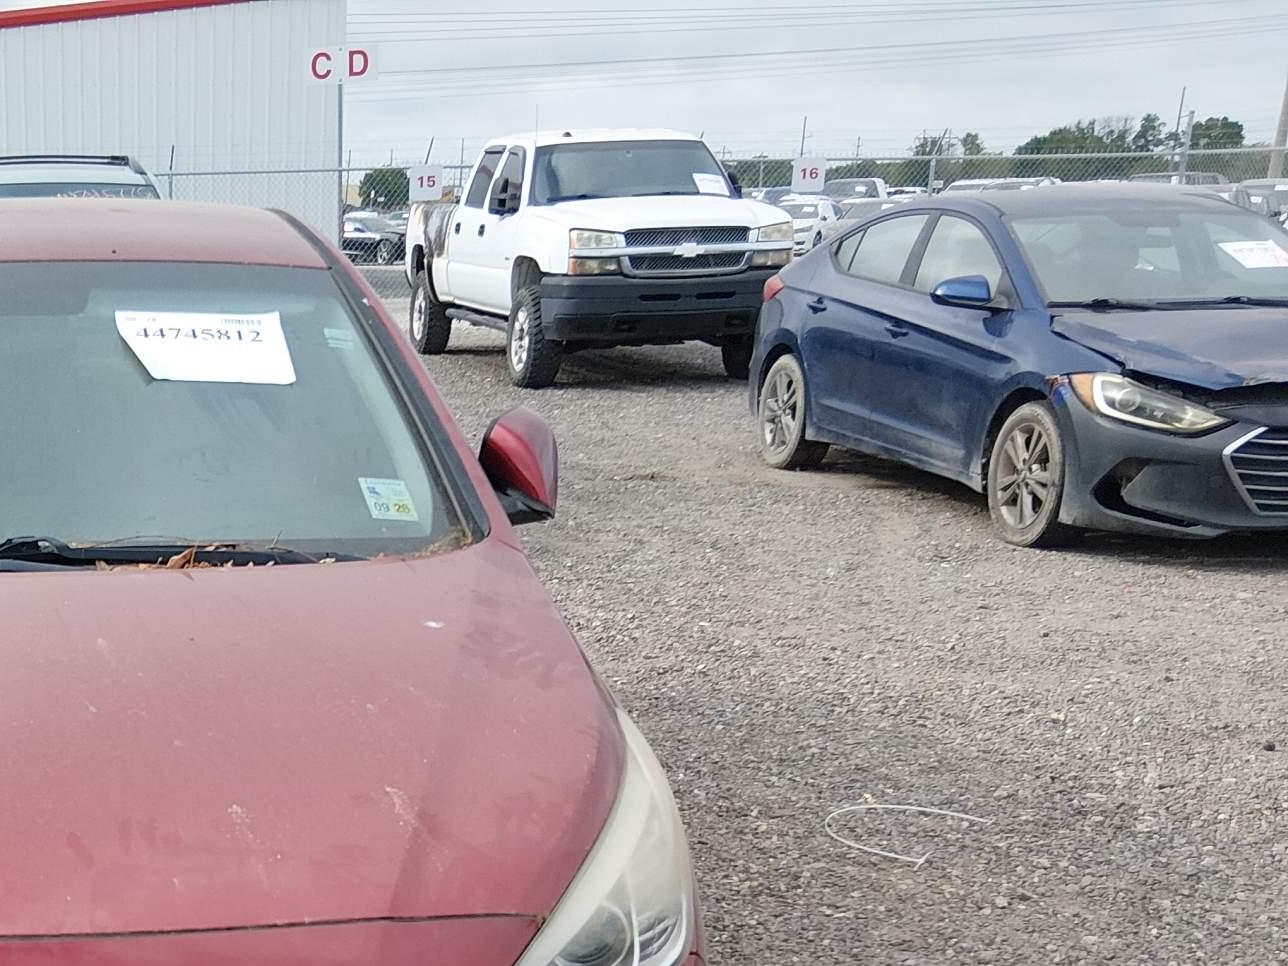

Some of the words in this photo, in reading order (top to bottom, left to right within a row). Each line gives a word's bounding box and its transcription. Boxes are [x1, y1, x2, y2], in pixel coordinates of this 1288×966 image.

[311, 52, 332, 80] C
[348, 50, 369, 77] D
[800, 167, 819, 180] 16
[417, 175, 436, 188] 15
[136, 327, 263, 342] 44745812
